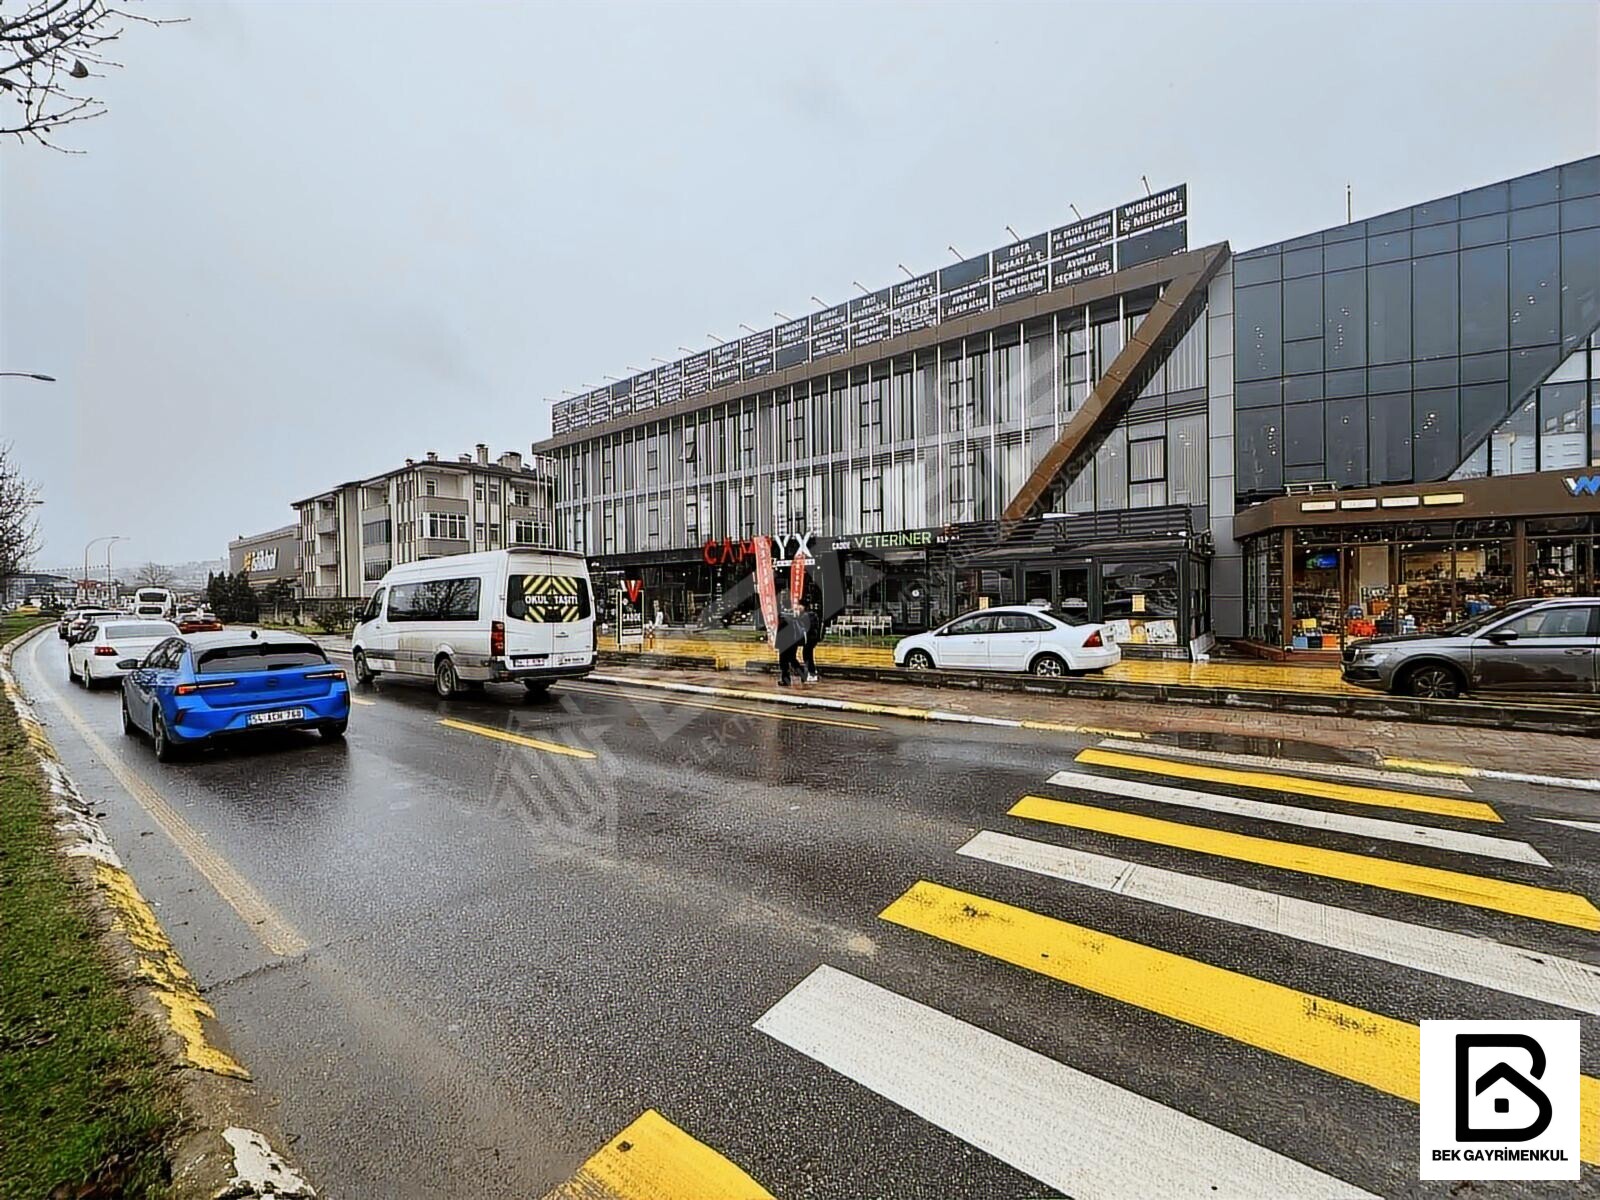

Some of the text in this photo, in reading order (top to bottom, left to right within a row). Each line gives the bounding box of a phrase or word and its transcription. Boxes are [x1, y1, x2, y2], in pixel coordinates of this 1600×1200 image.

[1125, 191, 1177, 217] WORKINN
[1120, 199, 1183, 232] İŞ MERKEZİ
[855, 532, 932, 548] VETERİNER
[525, 595, 548, 605] OKUL
